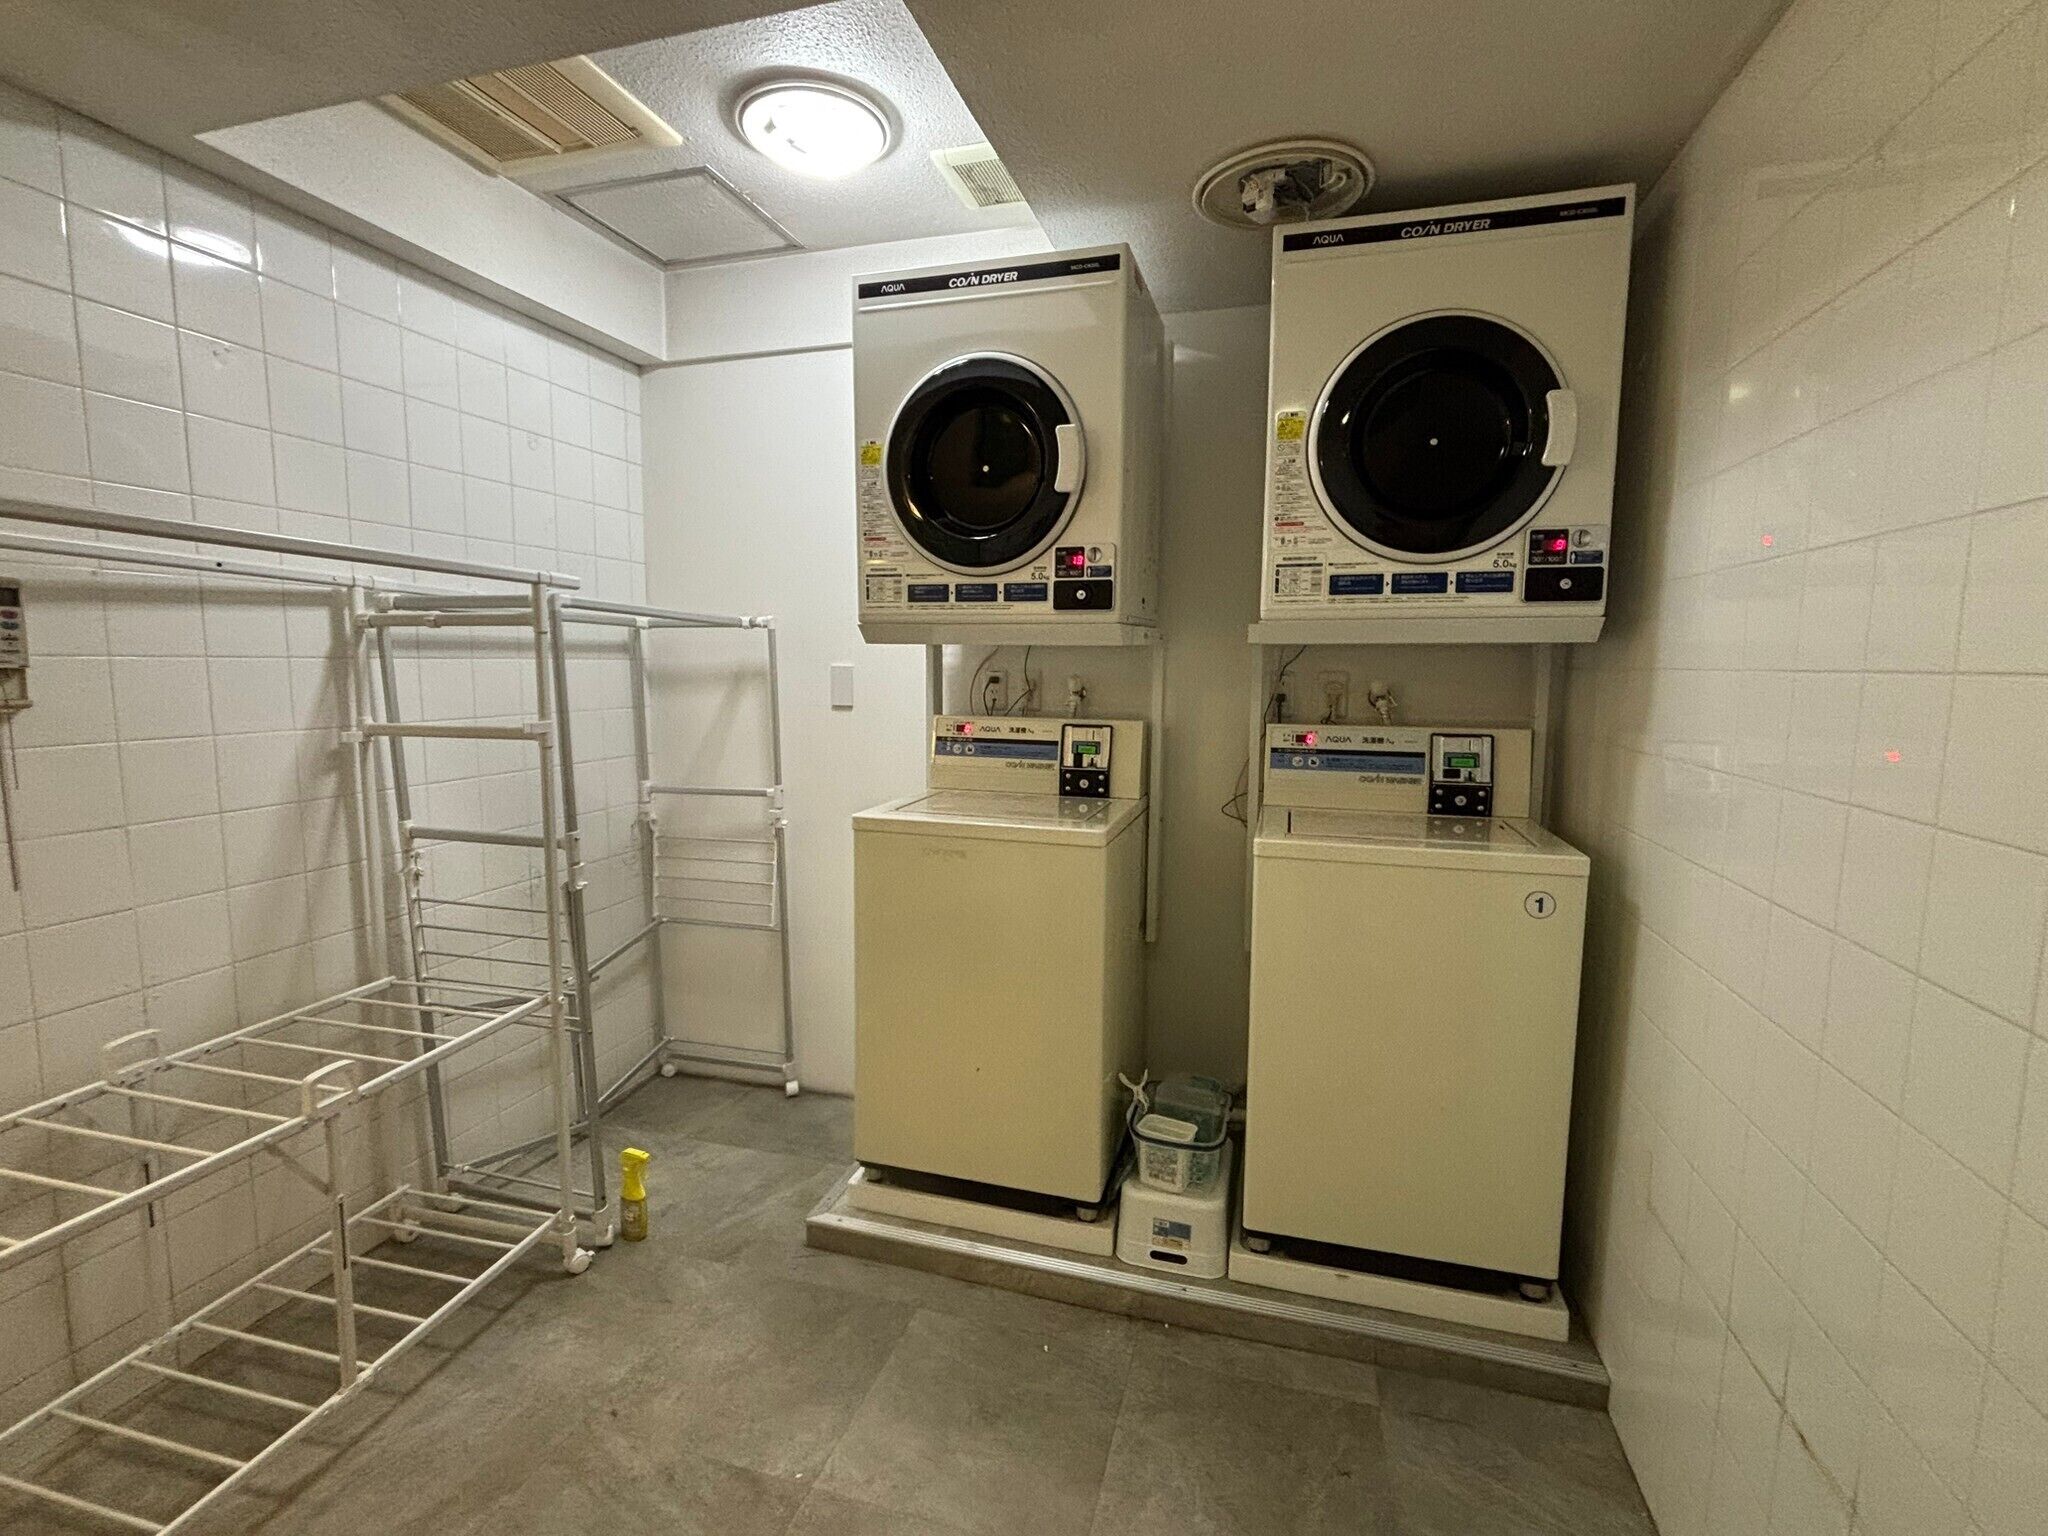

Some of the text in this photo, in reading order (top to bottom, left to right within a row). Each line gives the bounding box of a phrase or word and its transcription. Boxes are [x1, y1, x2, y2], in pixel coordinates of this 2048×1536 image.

[1400, 218, 1492, 239] COIN DRYER
[1312, 233, 1345, 245] AQUA
[948, 271, 1019, 288] COIN DRYER
[881, 283, 906, 293] AQUA
[1325, 735, 1352, 743] AQUA
